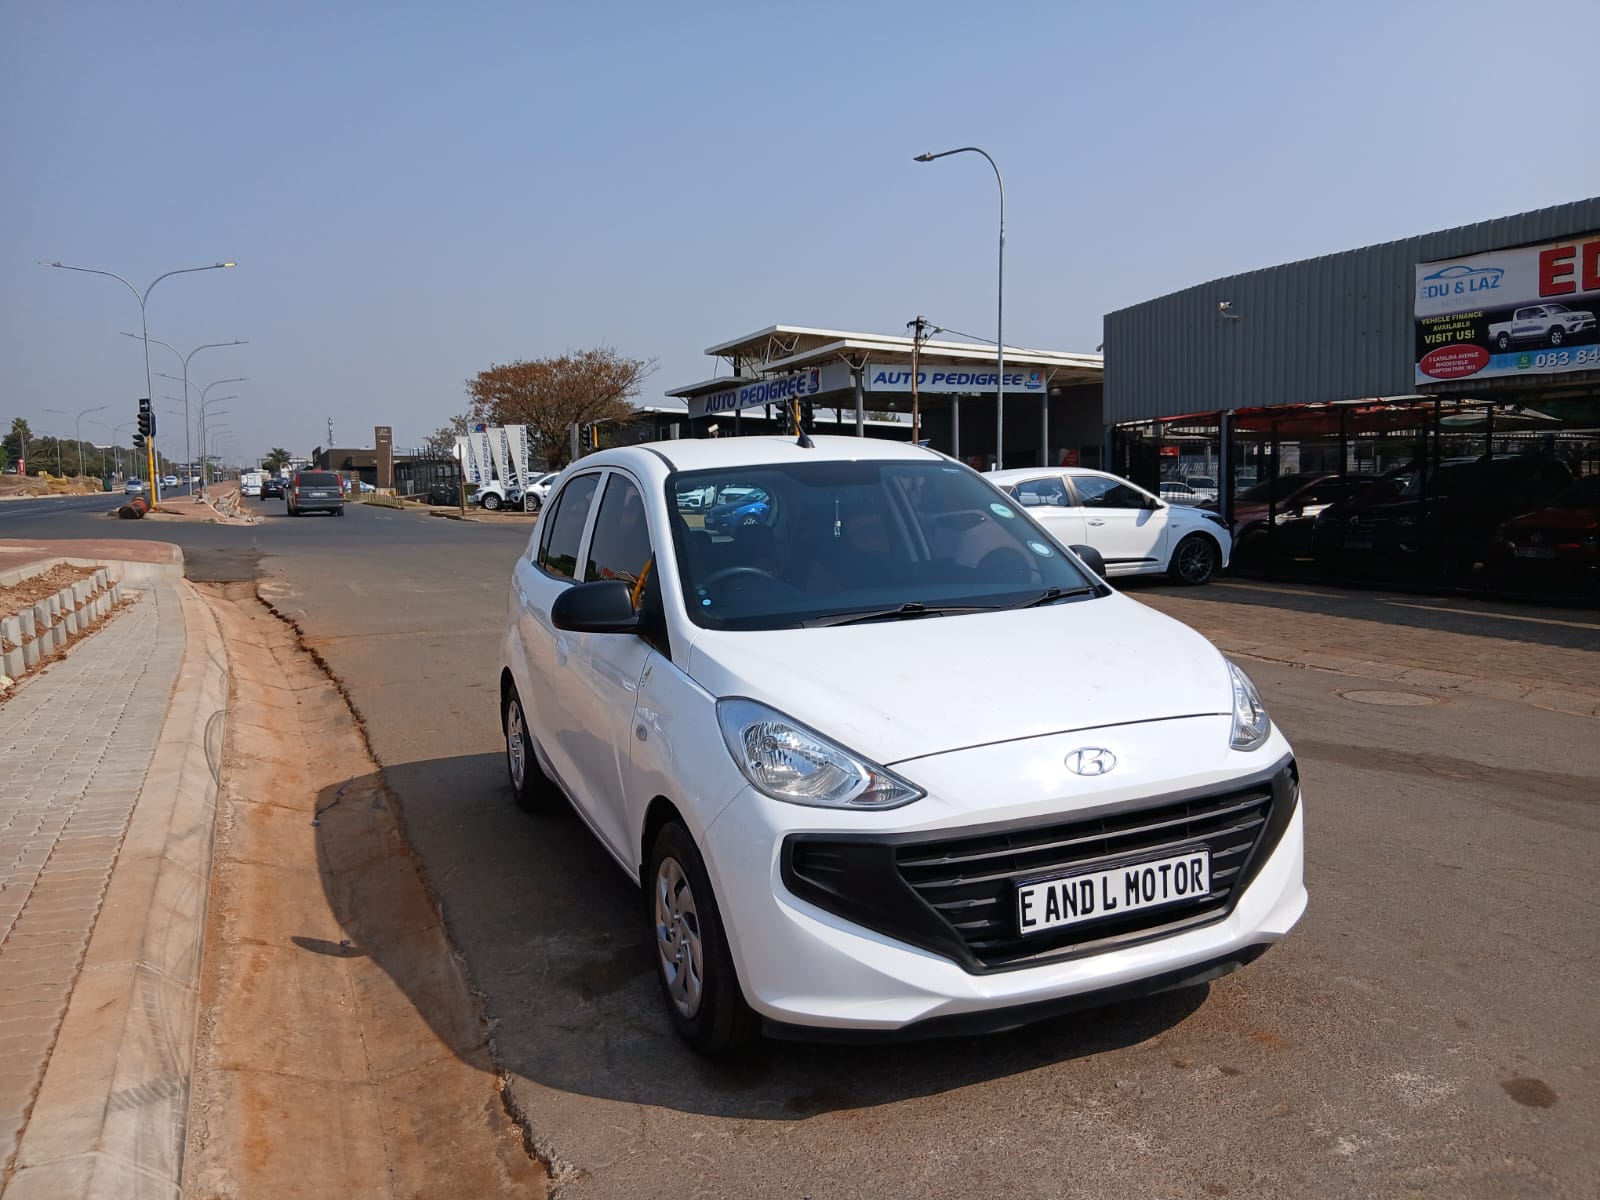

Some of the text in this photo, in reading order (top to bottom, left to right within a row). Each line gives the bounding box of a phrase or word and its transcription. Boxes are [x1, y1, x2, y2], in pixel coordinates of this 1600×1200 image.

[1454, 281, 1464, 294] &
[1469, 274, 1500, 292] LAZ
[1421, 311, 1484, 325] VEHICLE FINANCE
[1432, 321, 1471, 331] AVAILABLE
[1424, 328, 1475, 344] VISIT US!
[1432, 354, 1457, 362] CATALINA
[1458, 351, 1480, 359] AVENUE
[1536, 351, 1569, 368] 083
[873, 371, 927, 385] AUTO
[931, 372, 1024, 386] PEDIGREE
[705, 374, 806, 413] AUTO PEDIGREE
[482, 434, 490, 468] PEDIGREE
[500, 430, 508, 466] PEDIGREE
[521, 467, 529, 488] AUTO
[1020, 857, 1204, 927] E AND L MOTOR
